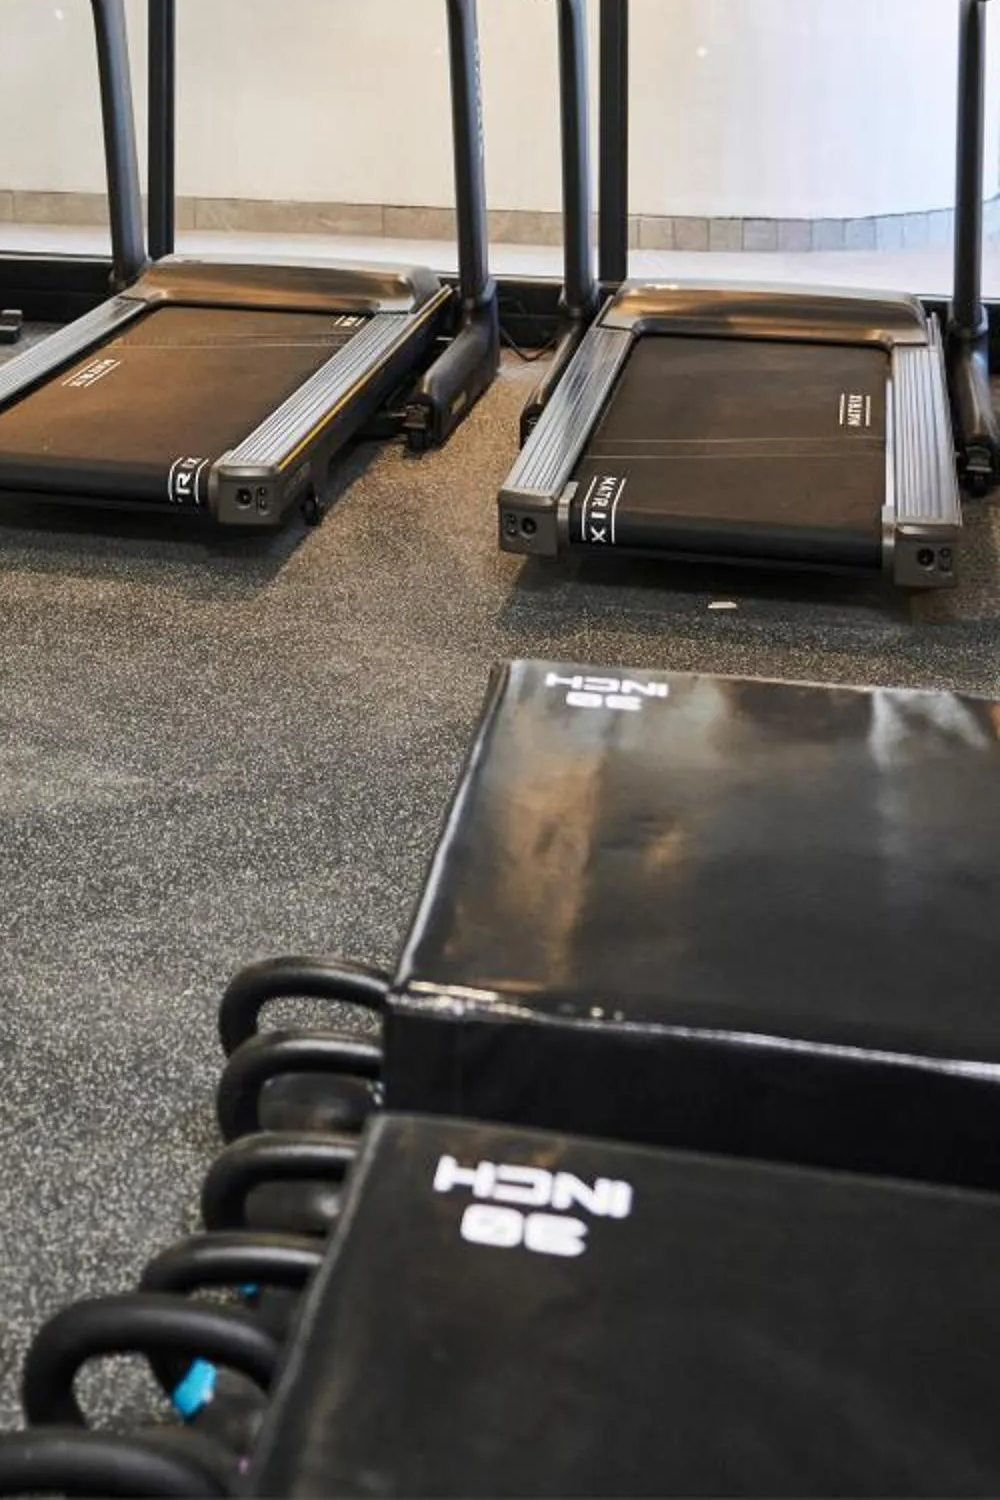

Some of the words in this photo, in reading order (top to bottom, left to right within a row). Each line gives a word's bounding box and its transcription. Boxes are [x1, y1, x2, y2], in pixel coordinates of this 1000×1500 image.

[590, 476, 618, 543] MATRIX
[544, 672, 669, 698] INCH
[433, 1154, 632, 1219] INCH
